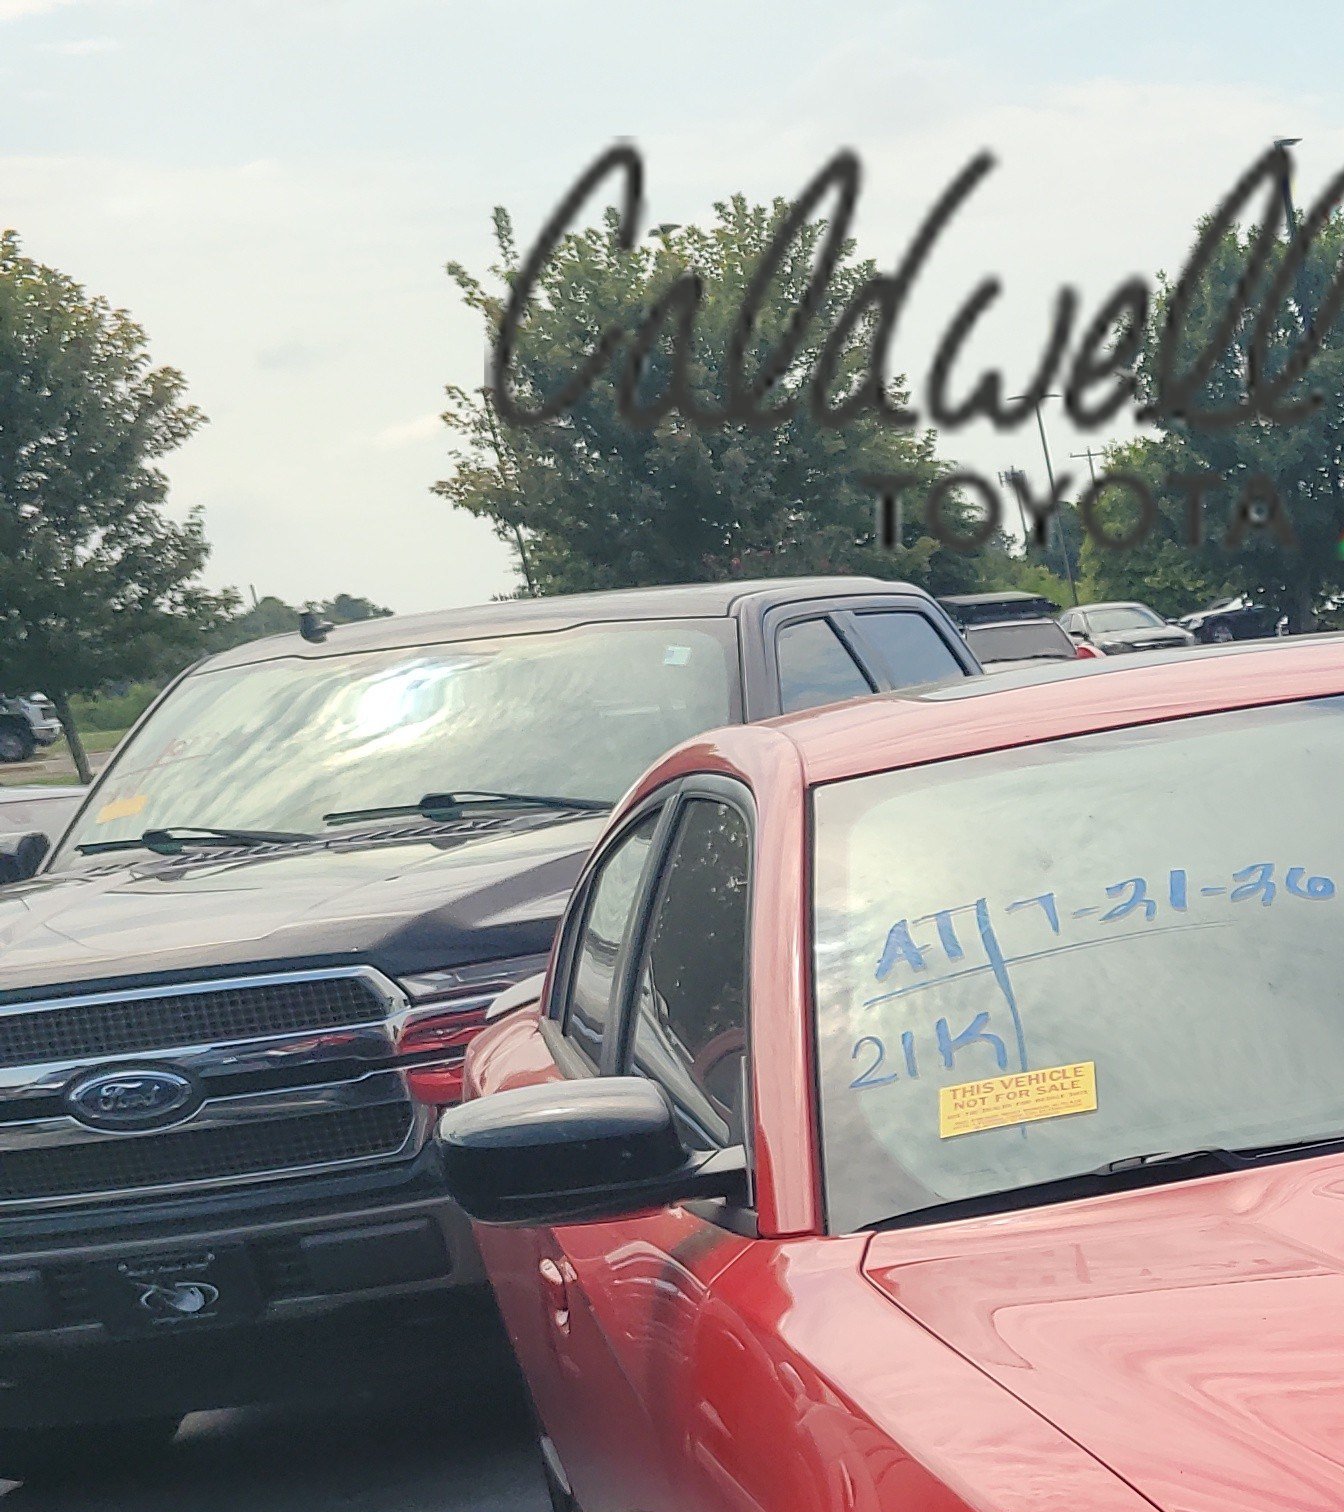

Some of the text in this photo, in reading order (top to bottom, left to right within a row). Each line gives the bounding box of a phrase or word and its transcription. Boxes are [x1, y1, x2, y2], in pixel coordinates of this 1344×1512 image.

[951, 1066, 1085, 1100] THIS VEHICLE
[954, 1096, 988, 1110] NOT
[995, 1089, 1030, 1102] FOR
[1037, 1080, 1082, 1095] SALE
